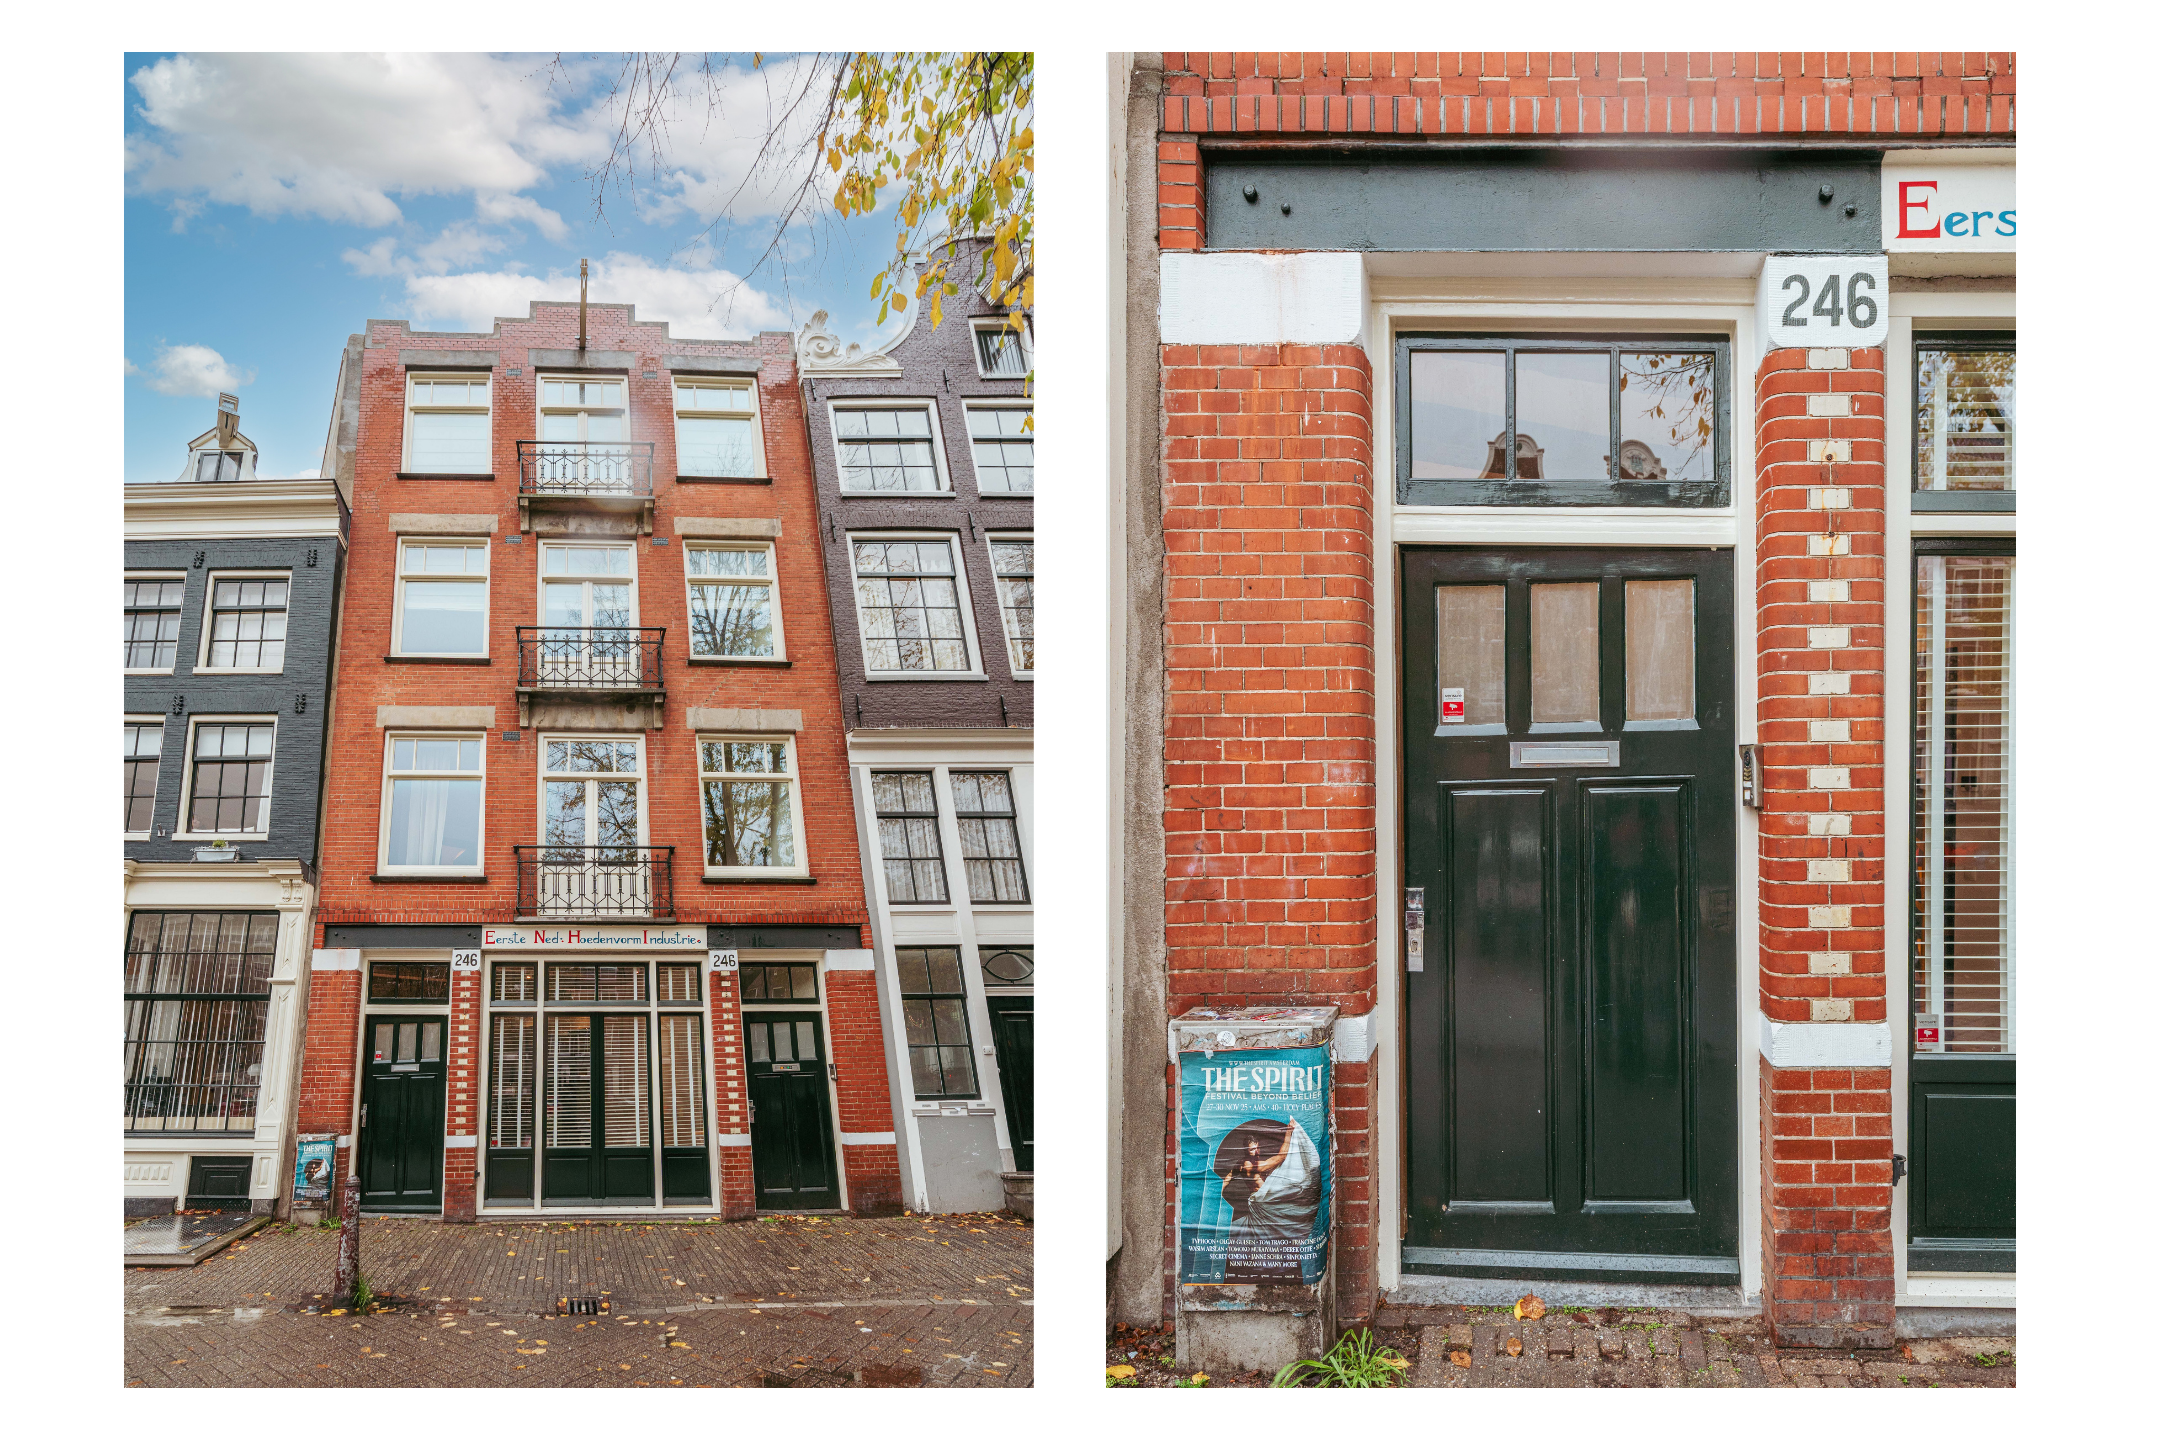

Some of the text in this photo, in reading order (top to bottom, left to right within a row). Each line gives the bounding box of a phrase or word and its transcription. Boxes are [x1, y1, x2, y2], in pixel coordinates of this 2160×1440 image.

[1895, 181, 2016, 239] Eers
[1782, 272, 1877, 328] 246
[485, 930, 526, 945] Eerste
[568, 930, 641, 944] Hoedenvorm
[455, 953, 478, 967] 246
[713, 954, 736, 967] 246
[1251, 1064, 1323, 1092] SPIRIT
[1205, 1092, 1248, 1100] FESTIVAL
[1292, 1091, 1321, 1100] BELIEF
[1226, 1103, 1239, 1111] NOV
